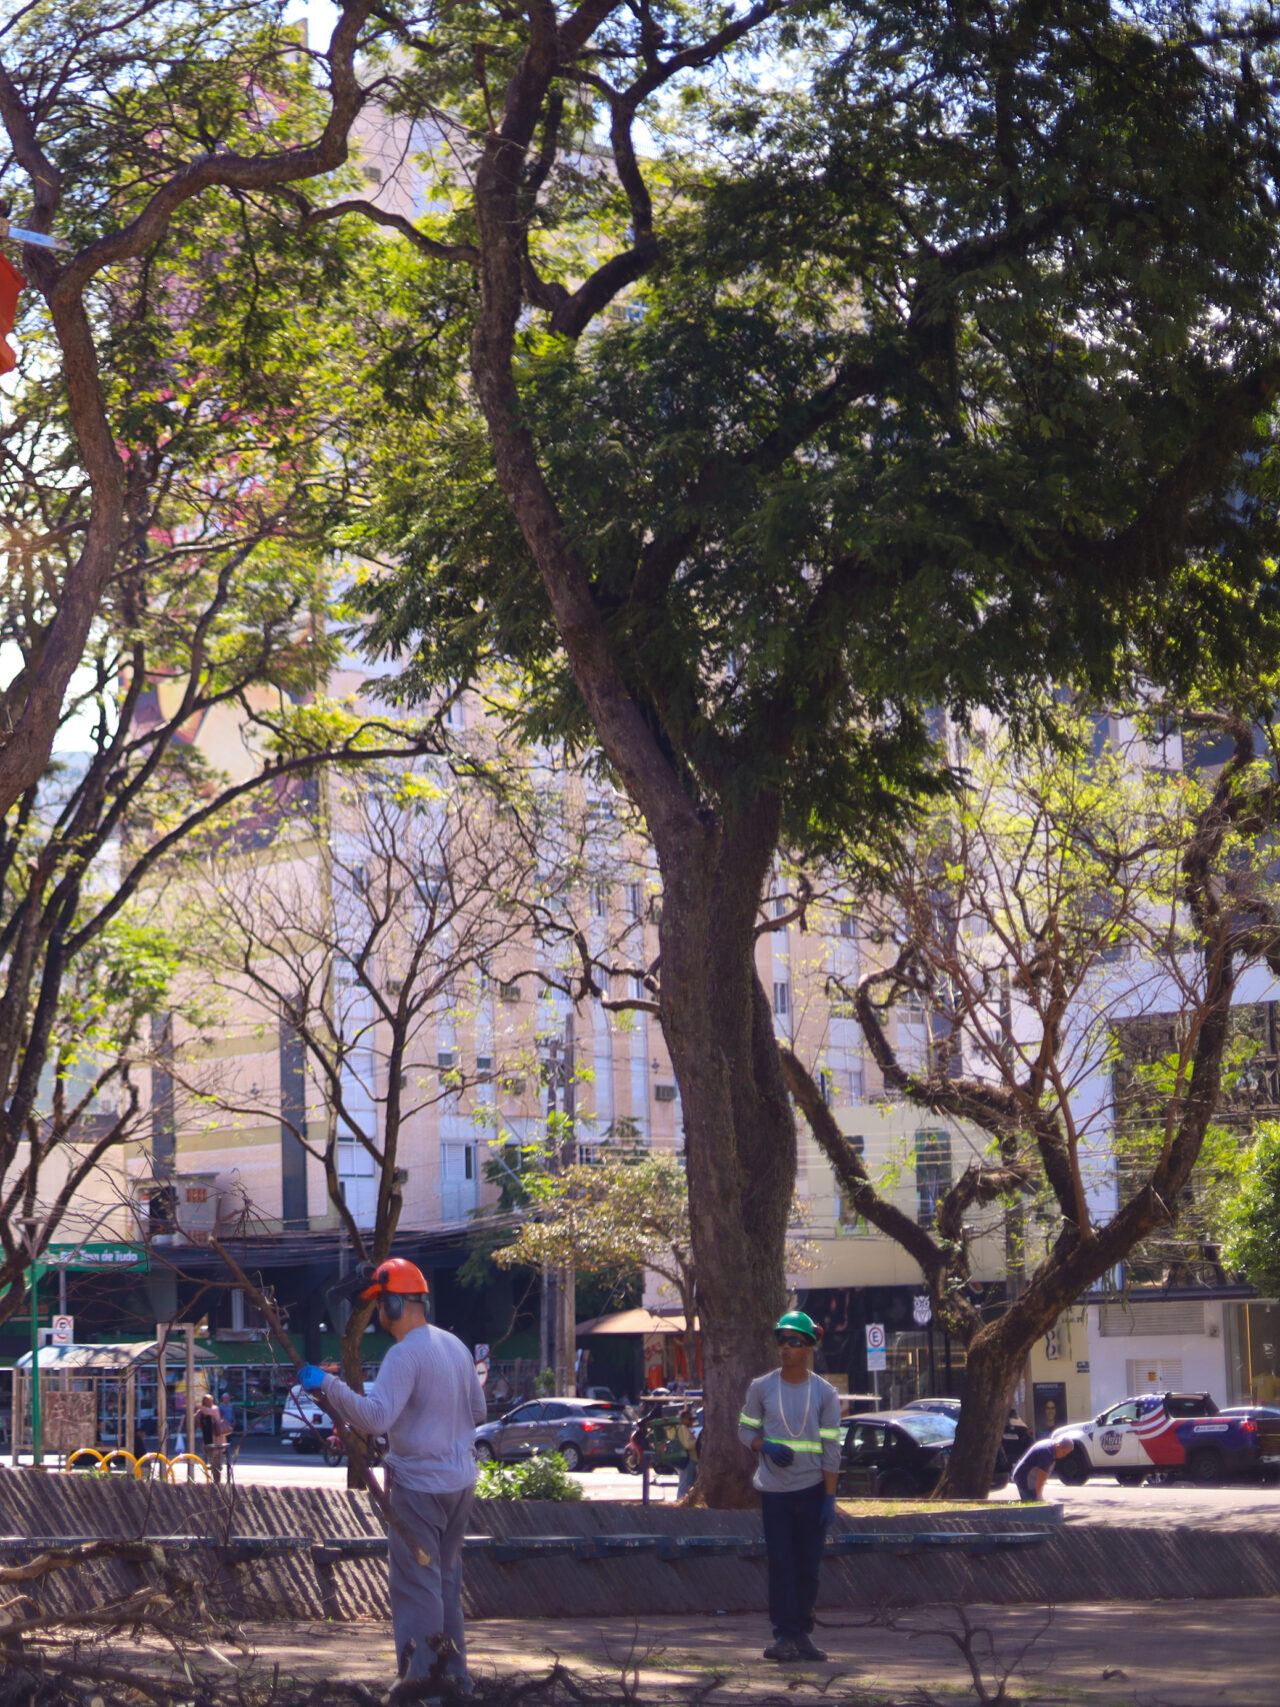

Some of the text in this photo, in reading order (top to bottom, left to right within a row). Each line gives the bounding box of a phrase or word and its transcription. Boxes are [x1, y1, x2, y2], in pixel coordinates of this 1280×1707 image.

[101, 1248, 114, 1262] de
[114, 1249, 138, 1262] Tudo
[872, 1331, 879, 1342] E
